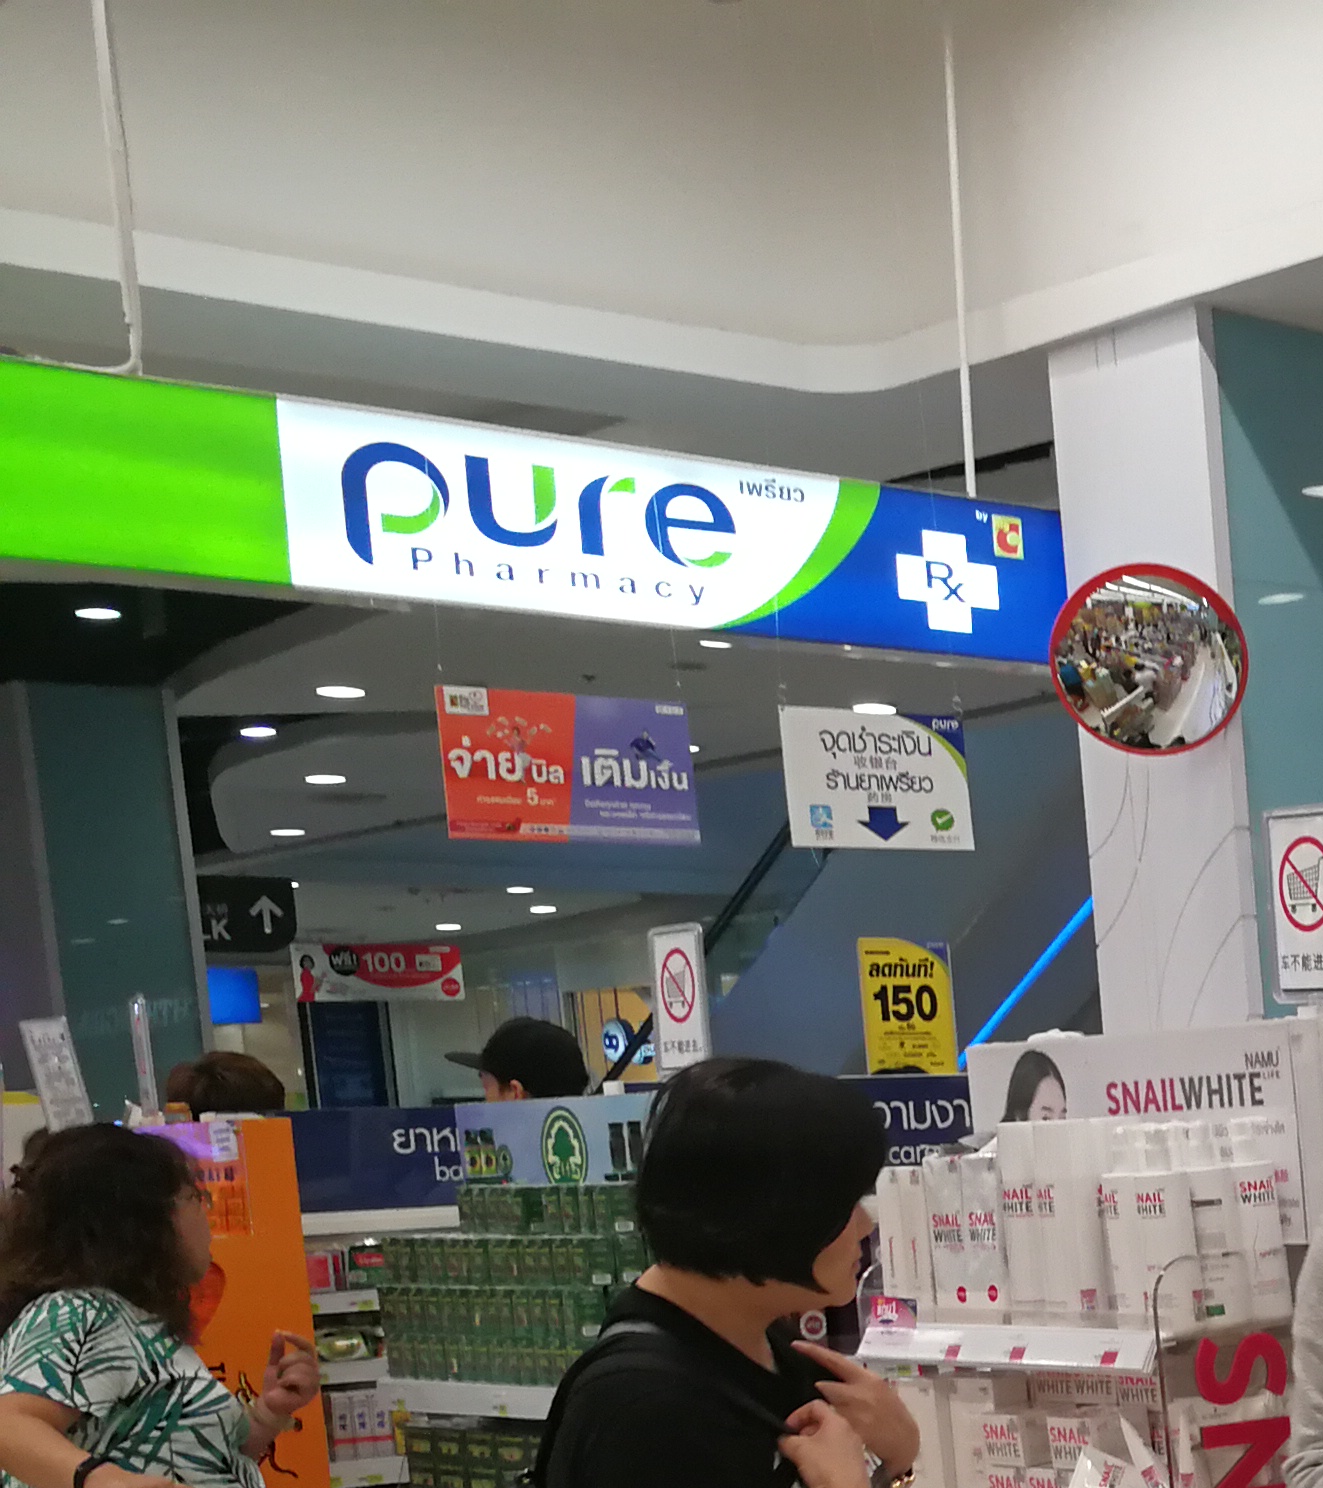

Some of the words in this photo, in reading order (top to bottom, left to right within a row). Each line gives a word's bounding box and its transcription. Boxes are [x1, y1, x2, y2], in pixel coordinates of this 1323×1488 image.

[341, 442, 736, 568] pure
[738, 478, 806, 504] เพรียว
[975, 510, 989, 525] by
[410, 546, 705, 608] Pharmacy
[362, 951, 406, 973] 100
[872, 983, 939, 1023] 150
[1244, 1051, 1280, 1070] NAMU
[1106, 1072, 1265, 1116] SNAILWHITE
